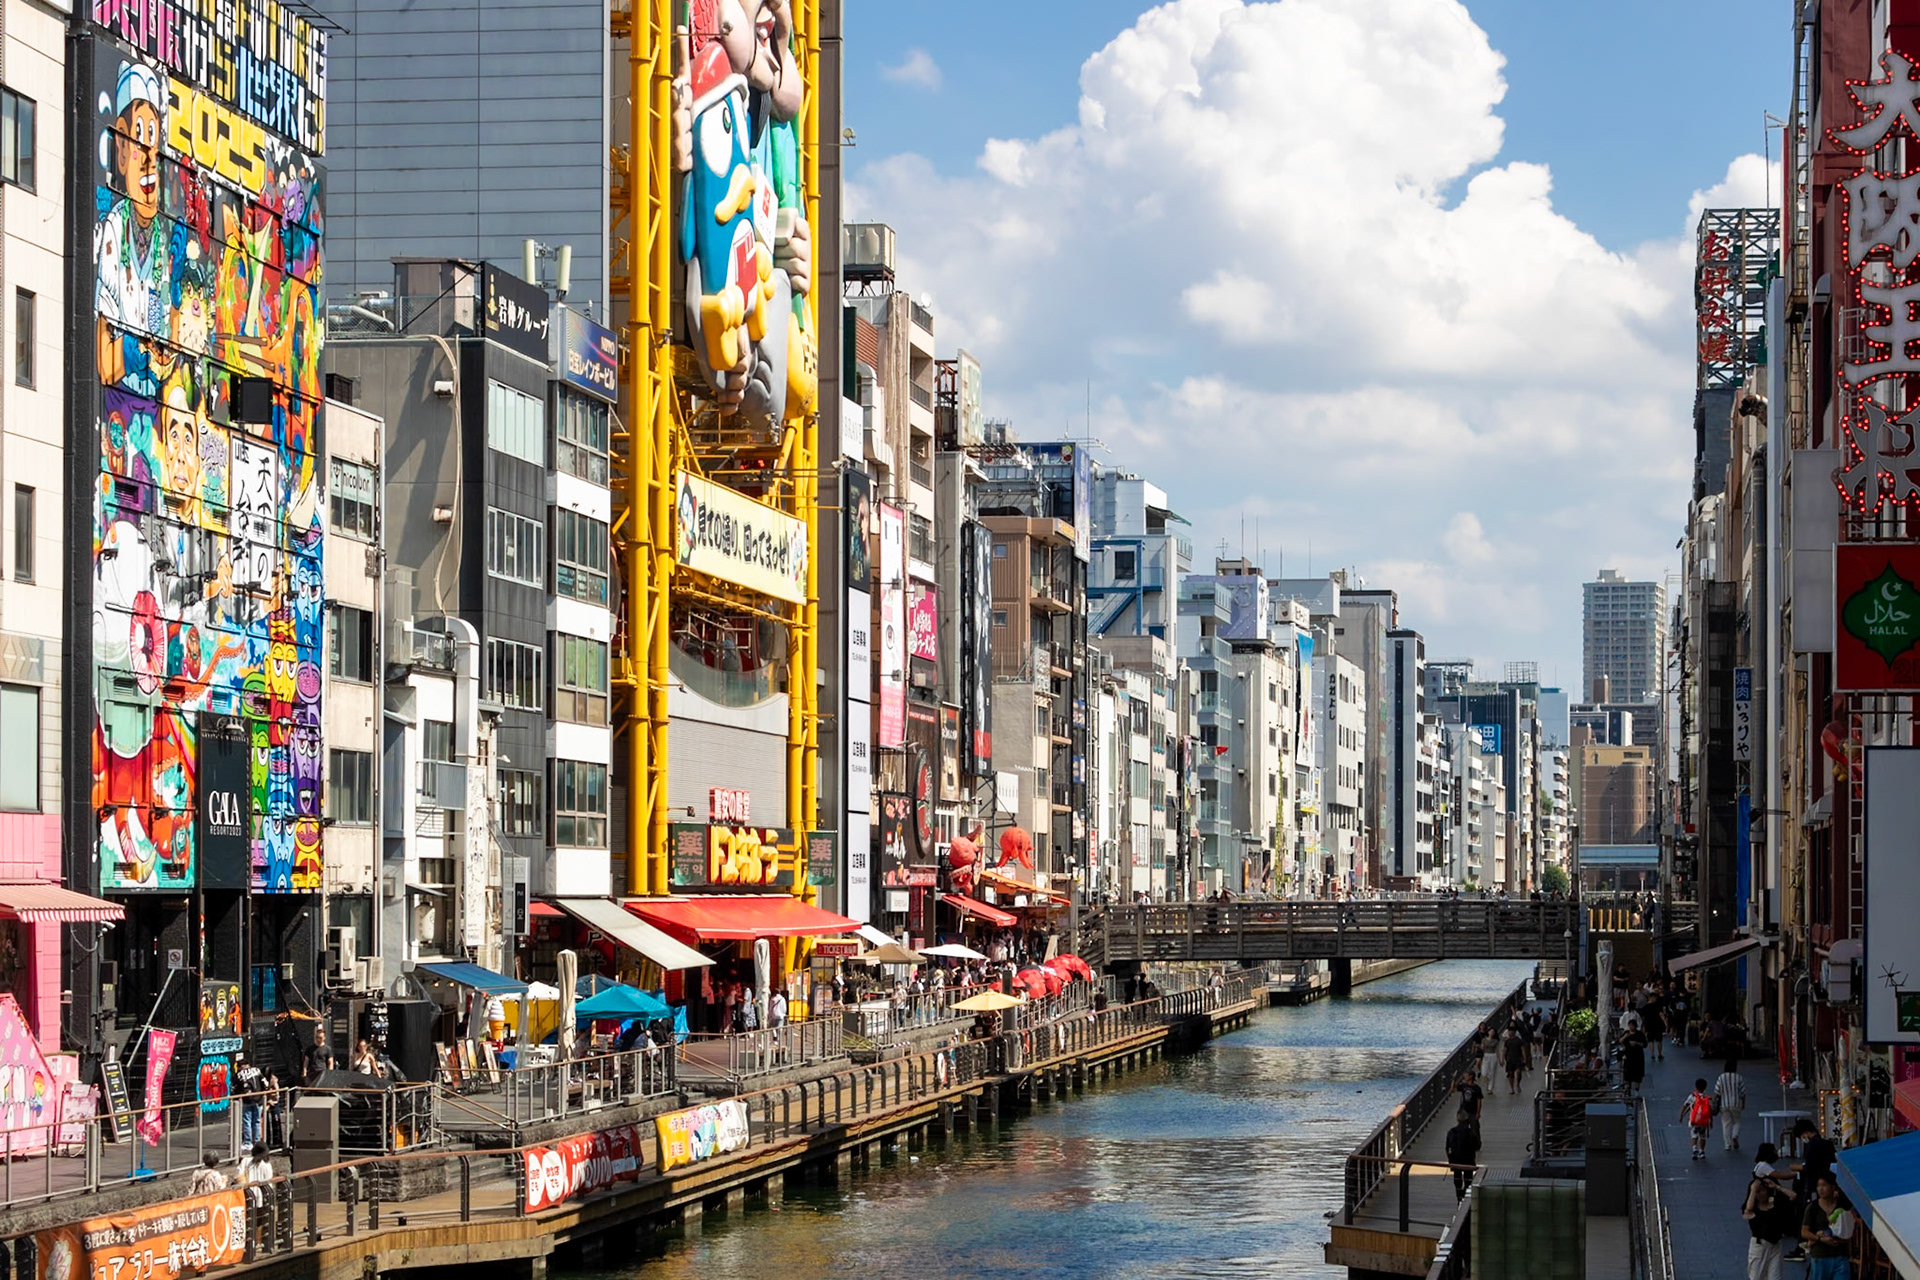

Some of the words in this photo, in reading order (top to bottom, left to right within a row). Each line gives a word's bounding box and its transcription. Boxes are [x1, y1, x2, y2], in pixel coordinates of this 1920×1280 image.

[168, 76, 266, 196] 2025
[1869, 626, 1908, 635] HALAL
[1736, 671, 1750, 699] 焼肉
[208, 790, 241, 826] GALA
[677, 831, 703, 857] 薬
